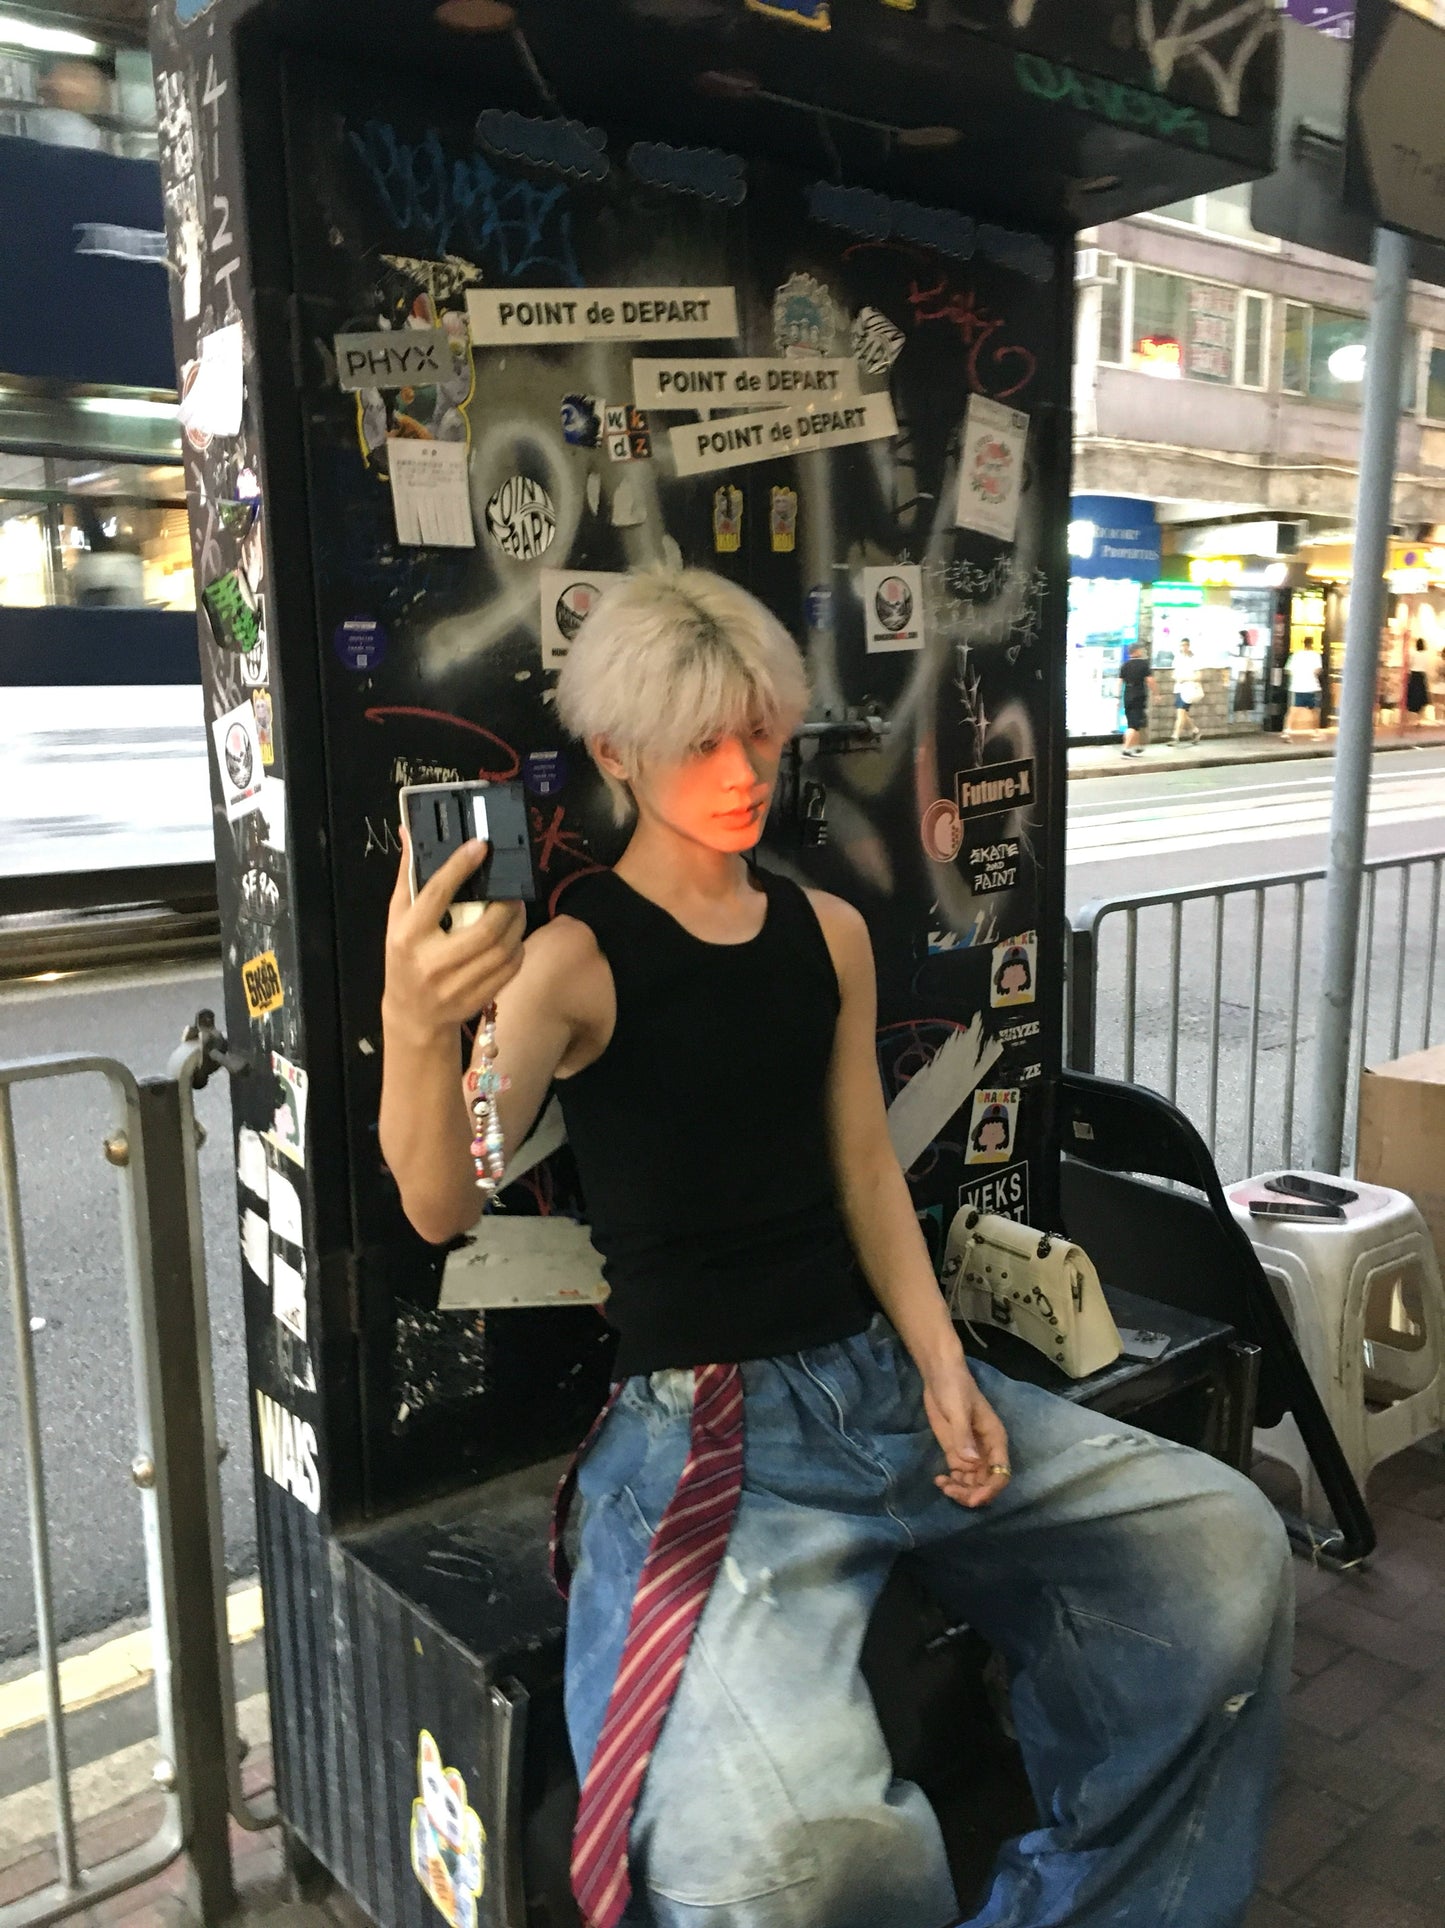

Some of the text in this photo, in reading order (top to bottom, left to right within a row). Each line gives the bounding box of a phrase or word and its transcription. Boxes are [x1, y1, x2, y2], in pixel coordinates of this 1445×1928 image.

[499, 299, 711, 325] POINT de DEPART
[346, 345, 438, 376] PHYX
[658, 369, 839, 393] POINT de DEPART
[697, 407, 867, 457] POINT de DEPART
[962, 770, 1031, 808] Future-X
[969, 843, 1019, 865] SKATE
[975, 868, 1017, 891] PAINT
[967, 1173, 1021, 1213] VEKS
